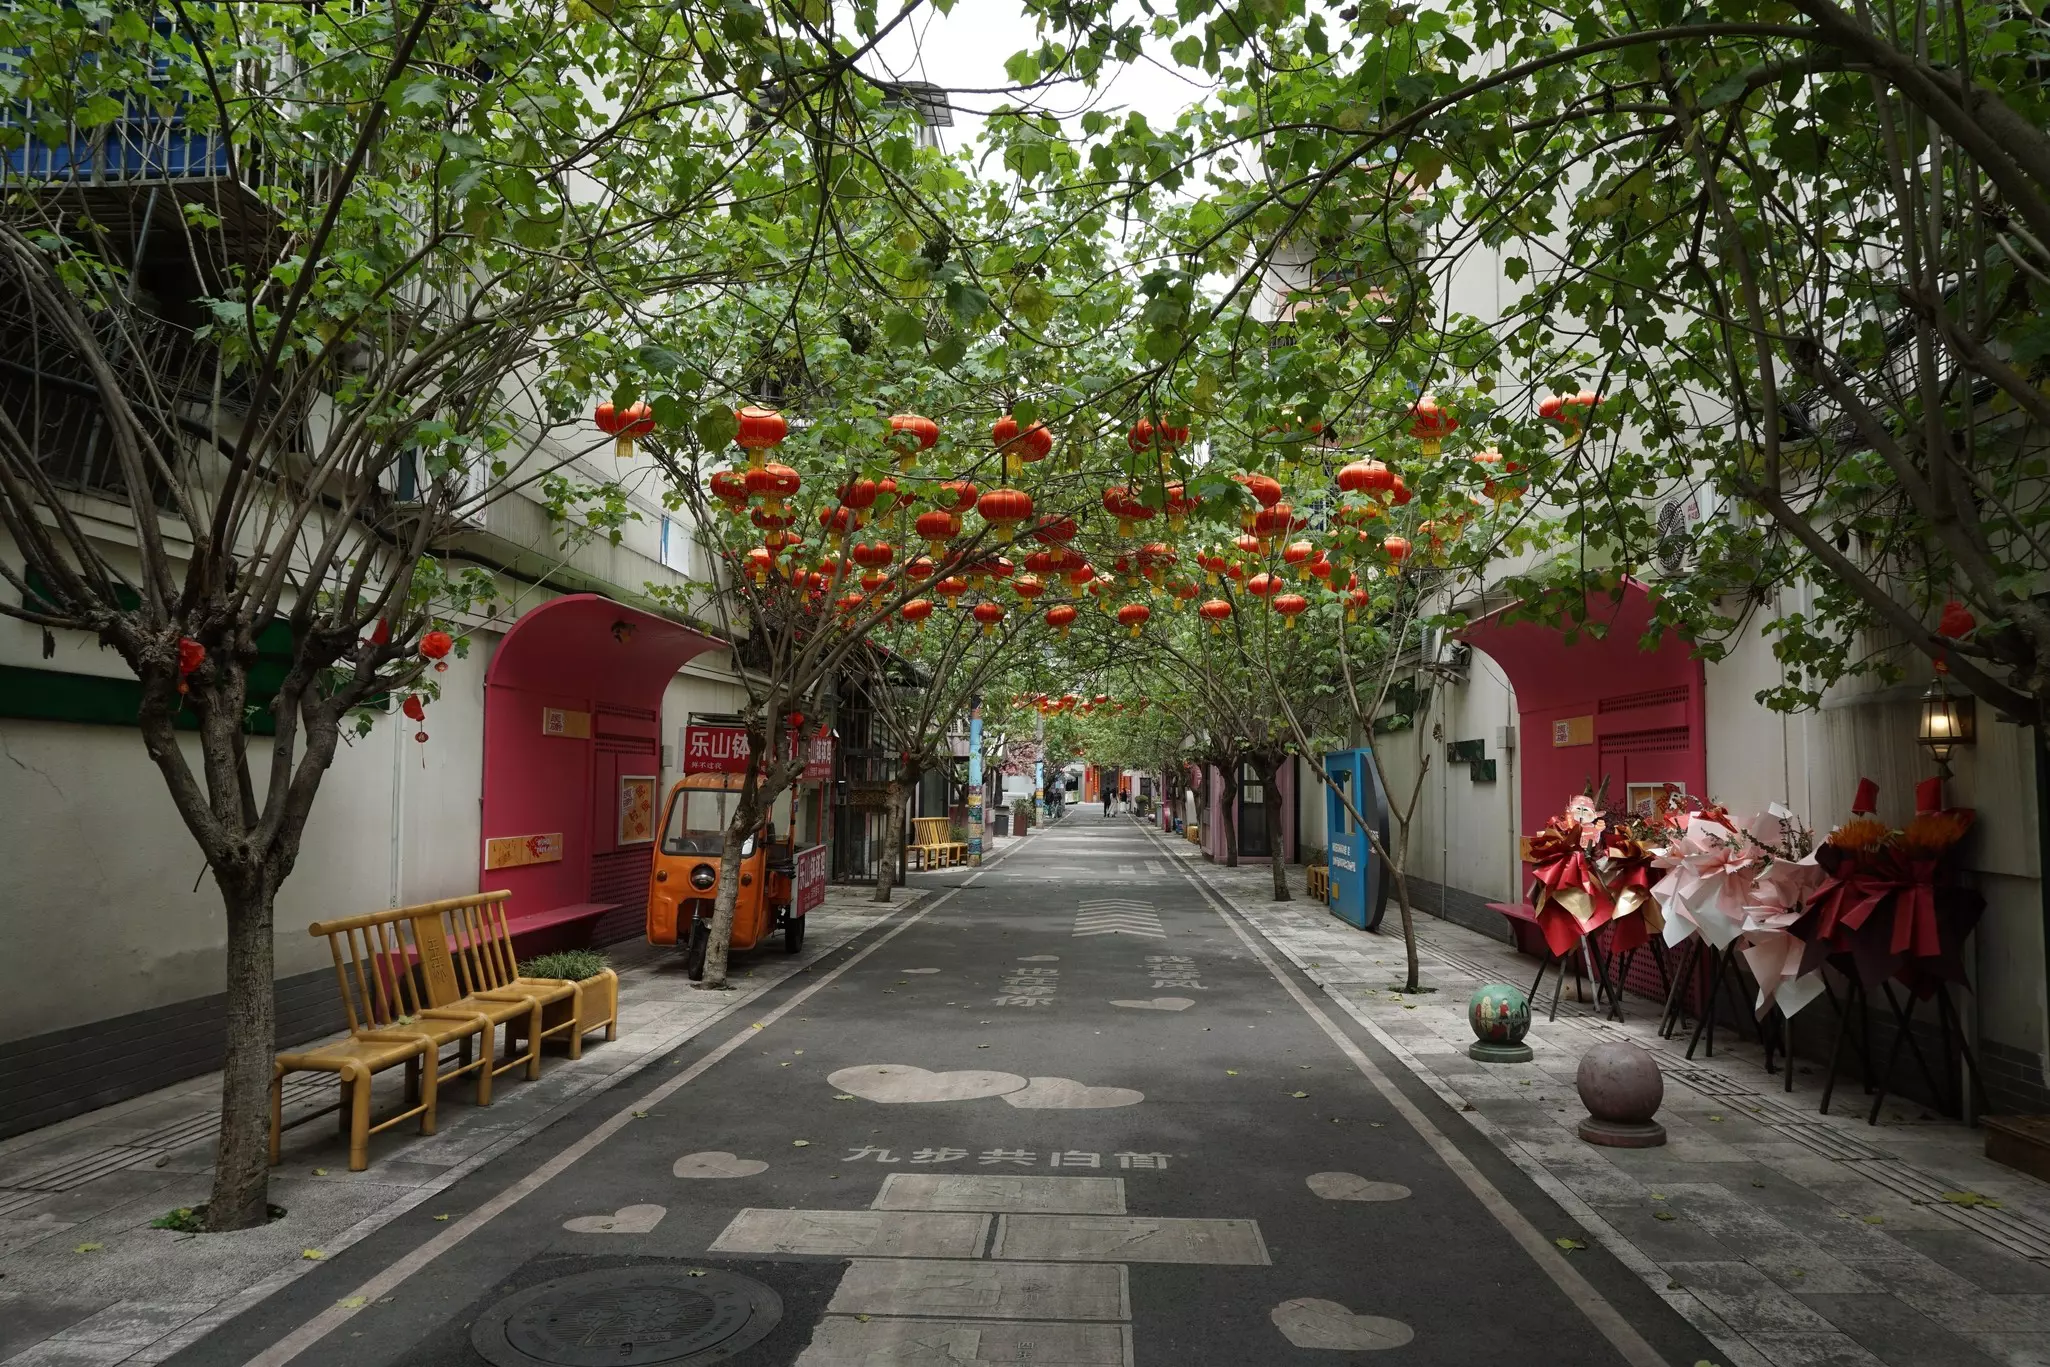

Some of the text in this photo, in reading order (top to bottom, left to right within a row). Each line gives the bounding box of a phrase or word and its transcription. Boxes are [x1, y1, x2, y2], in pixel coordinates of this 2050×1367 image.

[991, 967, 1060, 1007] 也在等你
[1144, 955, 1209, 990] 我在等风
[841, 1145, 1173, 1170] 九步共白首
